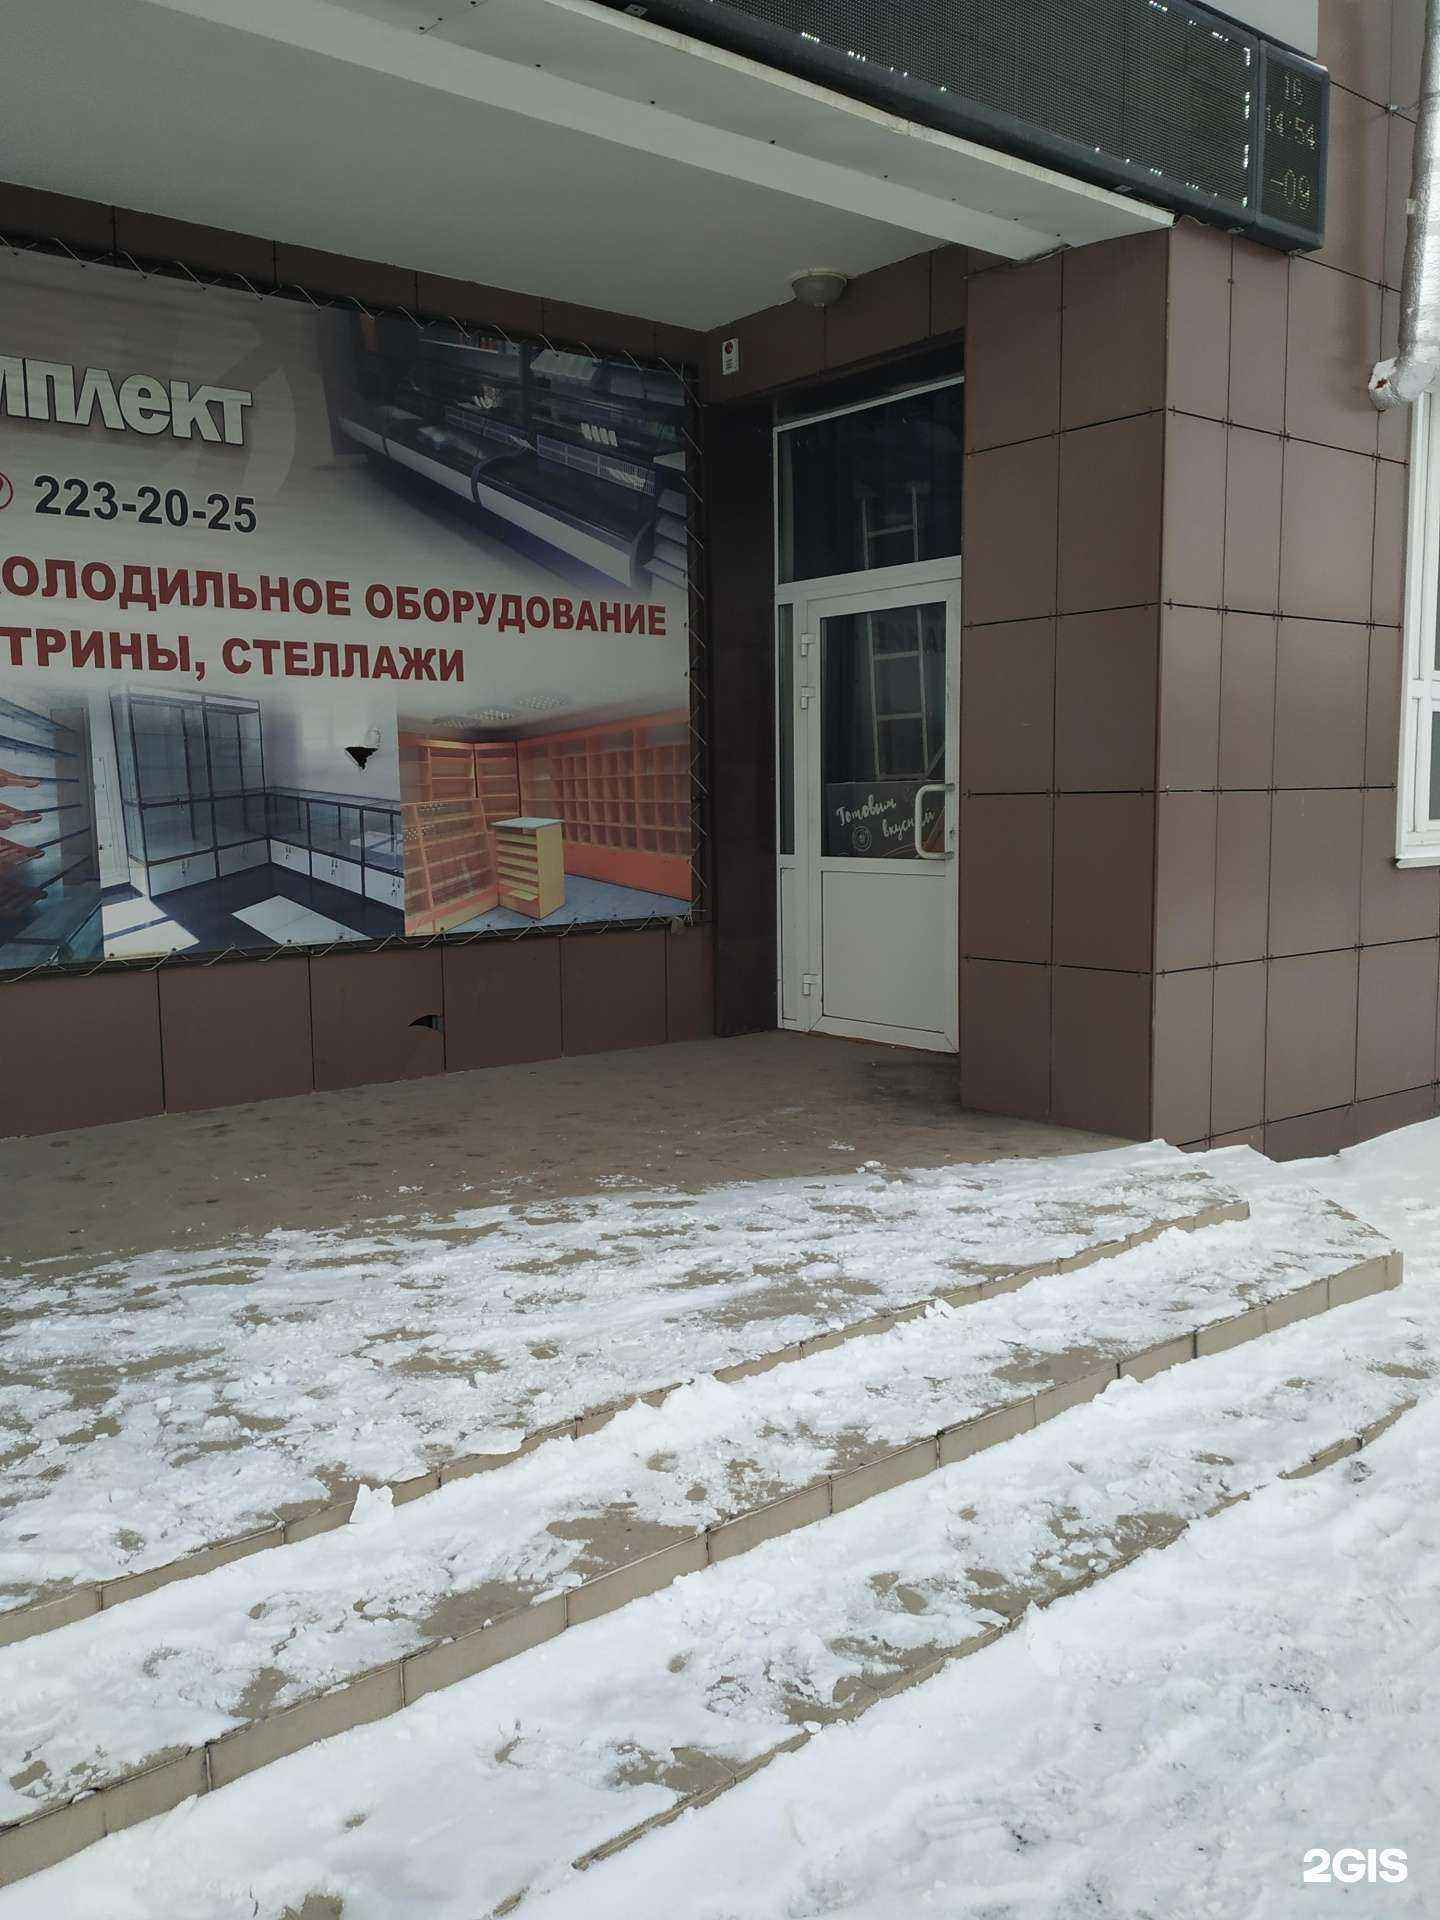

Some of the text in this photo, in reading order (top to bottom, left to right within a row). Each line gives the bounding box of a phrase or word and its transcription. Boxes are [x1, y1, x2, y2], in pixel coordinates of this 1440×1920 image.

[33, 475, 257, 533] 223-20-25
[0, 556, 667, 636] ОЛОДИЛЬНОЕ ОБОРУДОВАНИЕ
[222, 637, 464, 682] СТЕЛЛАЖИ
